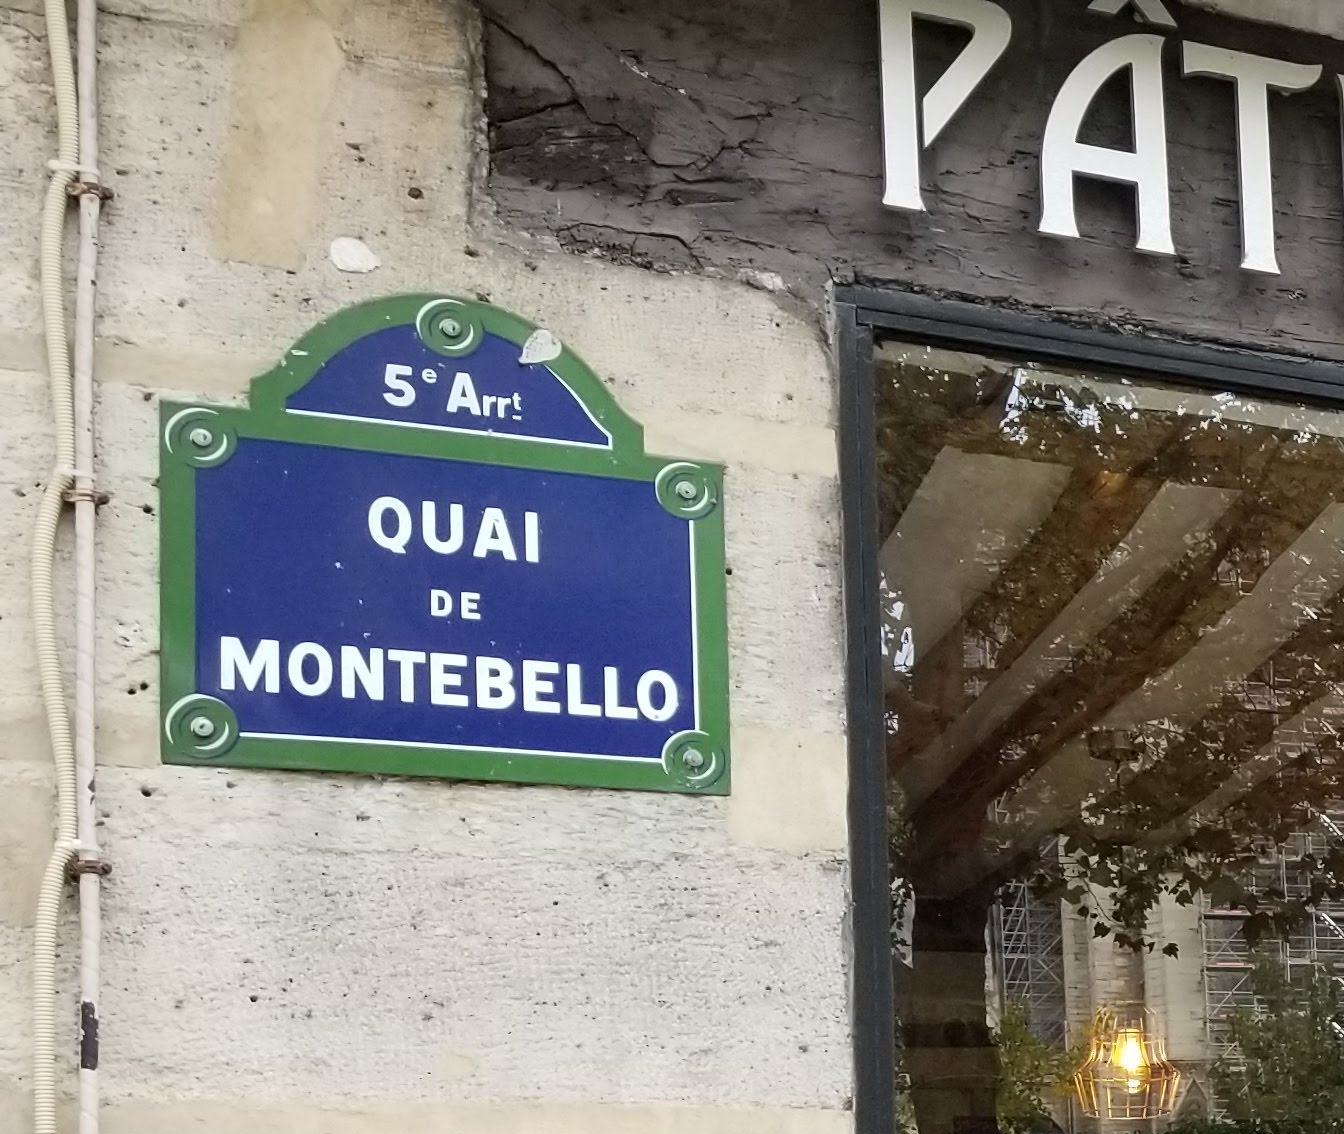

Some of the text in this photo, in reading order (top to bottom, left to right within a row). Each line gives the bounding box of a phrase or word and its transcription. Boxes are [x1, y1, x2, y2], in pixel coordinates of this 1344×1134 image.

[367, 495, 540, 563] QUAI
[430, 588, 481, 620] DE
[218, 636, 679, 722] MONTEBELLO
